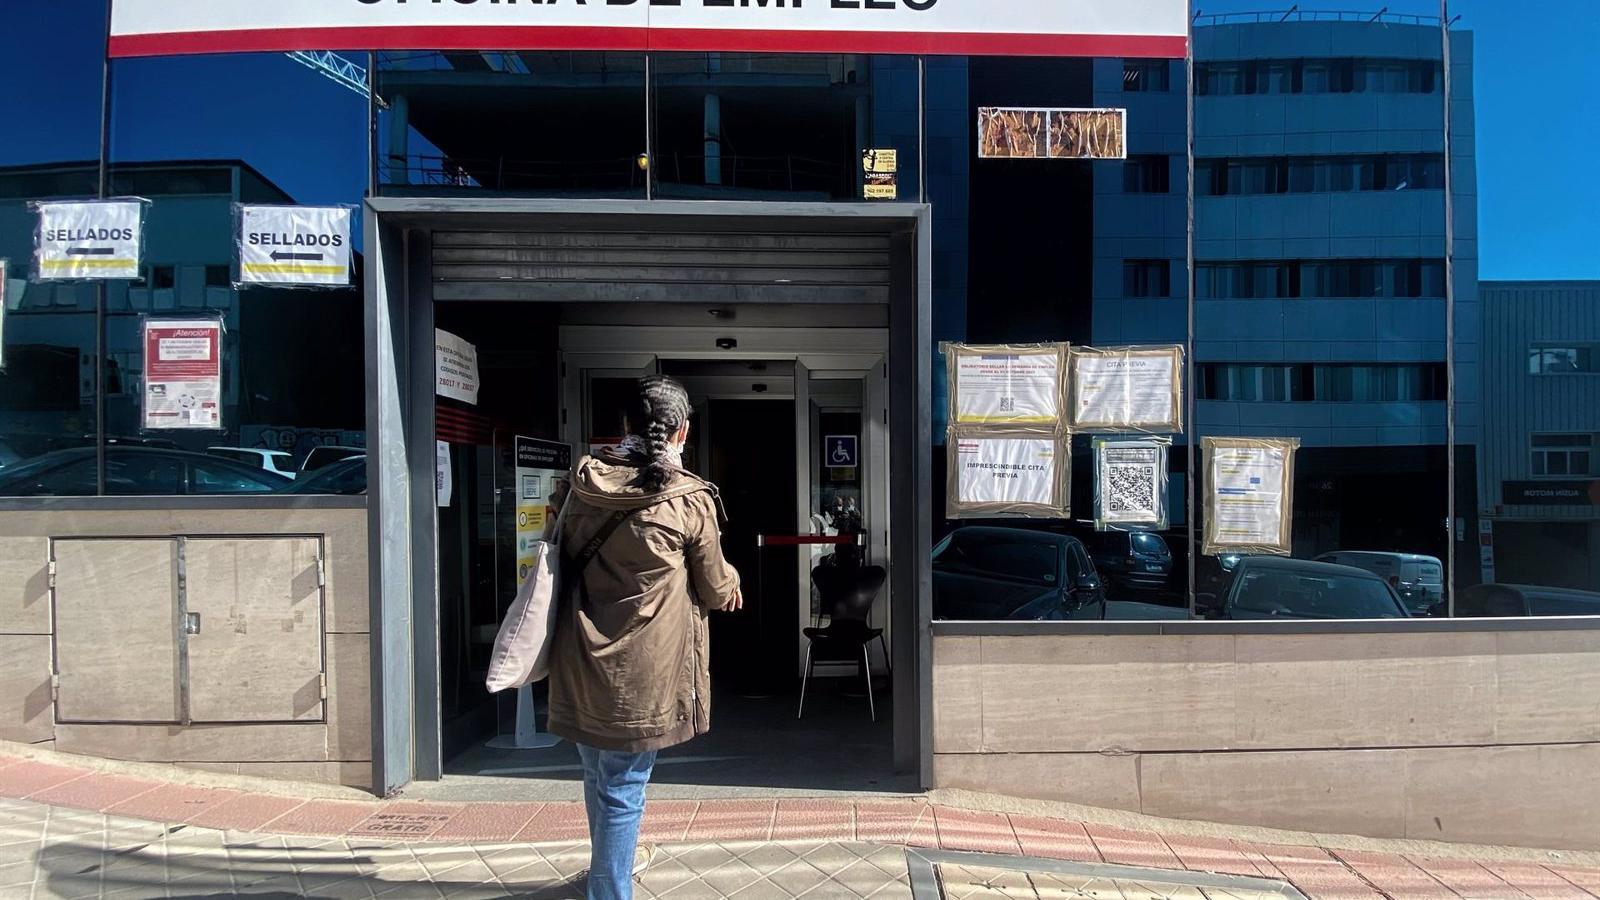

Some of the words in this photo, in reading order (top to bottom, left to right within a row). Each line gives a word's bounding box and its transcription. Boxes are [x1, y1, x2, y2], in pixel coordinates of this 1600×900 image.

[46, 228, 133, 242] SELLADOS
[248, 233, 343, 247] SELLADOS
[173, 328, 210, 338] ¡Atención!
[967, 463, 1026, 471] IMPRESCINDIBLE
[367, 824, 430, 832] GRATIS
